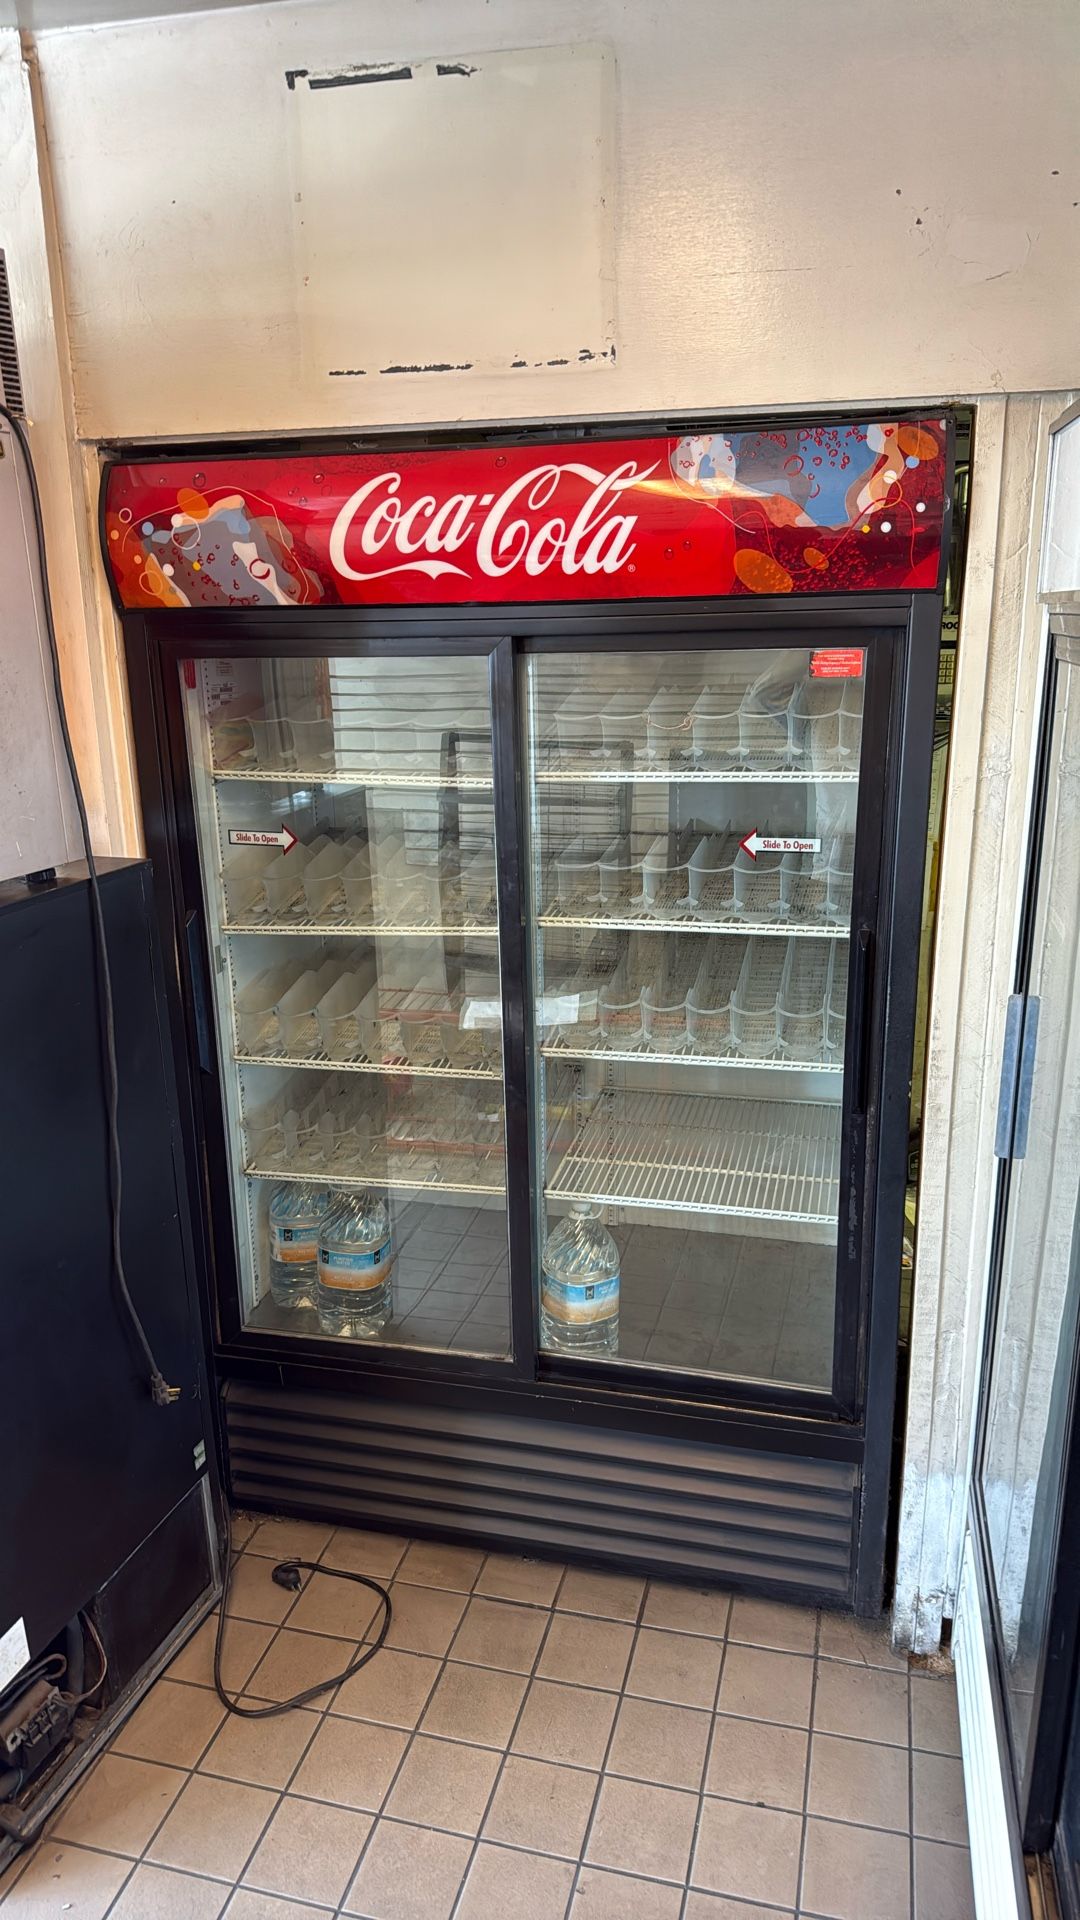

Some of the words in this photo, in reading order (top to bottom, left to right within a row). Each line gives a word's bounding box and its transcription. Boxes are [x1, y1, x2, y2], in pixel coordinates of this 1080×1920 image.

[329, 459, 662, 581] Coca-Cola
[235, 832, 252, 842] Slide
[253, 833, 260, 842] To
[261, 834, 279, 844] Open
[762, 839, 781, 849] Slide
[783, 840, 791, 849] To
[793, 840, 814, 851] Open
